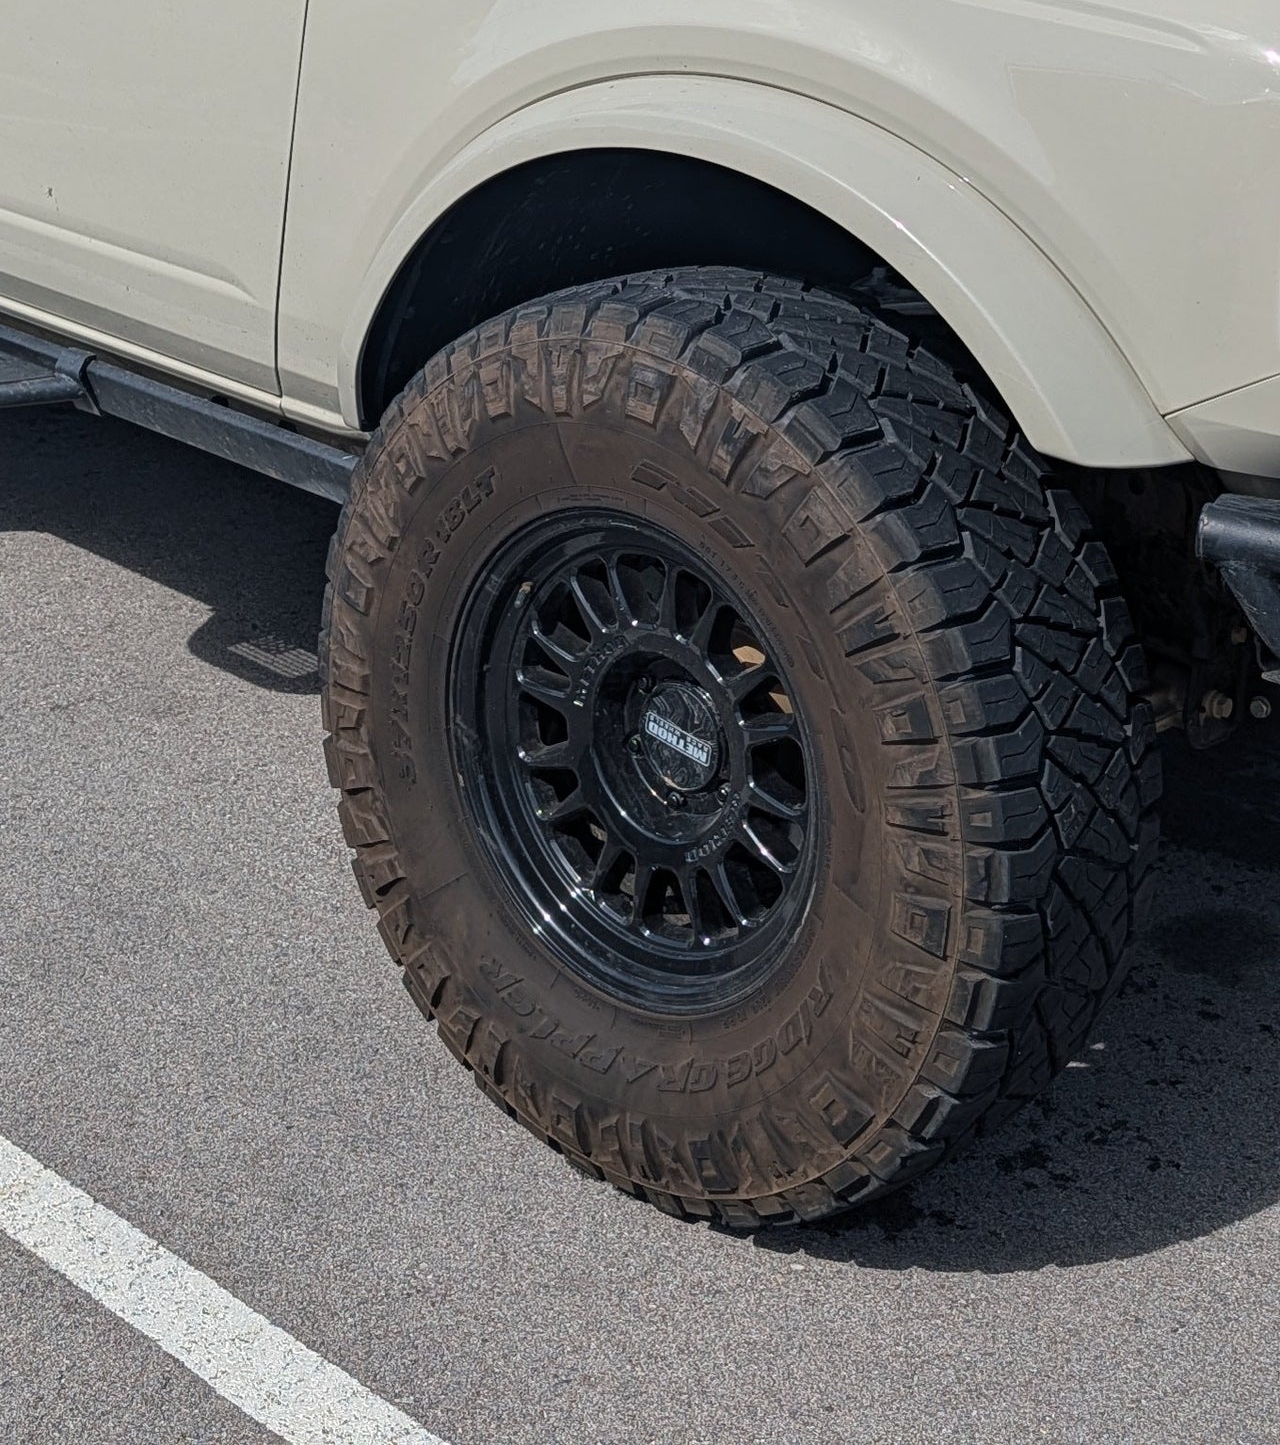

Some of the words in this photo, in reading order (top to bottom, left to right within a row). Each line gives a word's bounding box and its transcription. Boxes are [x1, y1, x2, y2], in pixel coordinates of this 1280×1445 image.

[648, 719, 709, 764] METHOD
[480, 956, 719, 1094] GRAPPLER
[726, 956, 834, 1090] RIDGE
